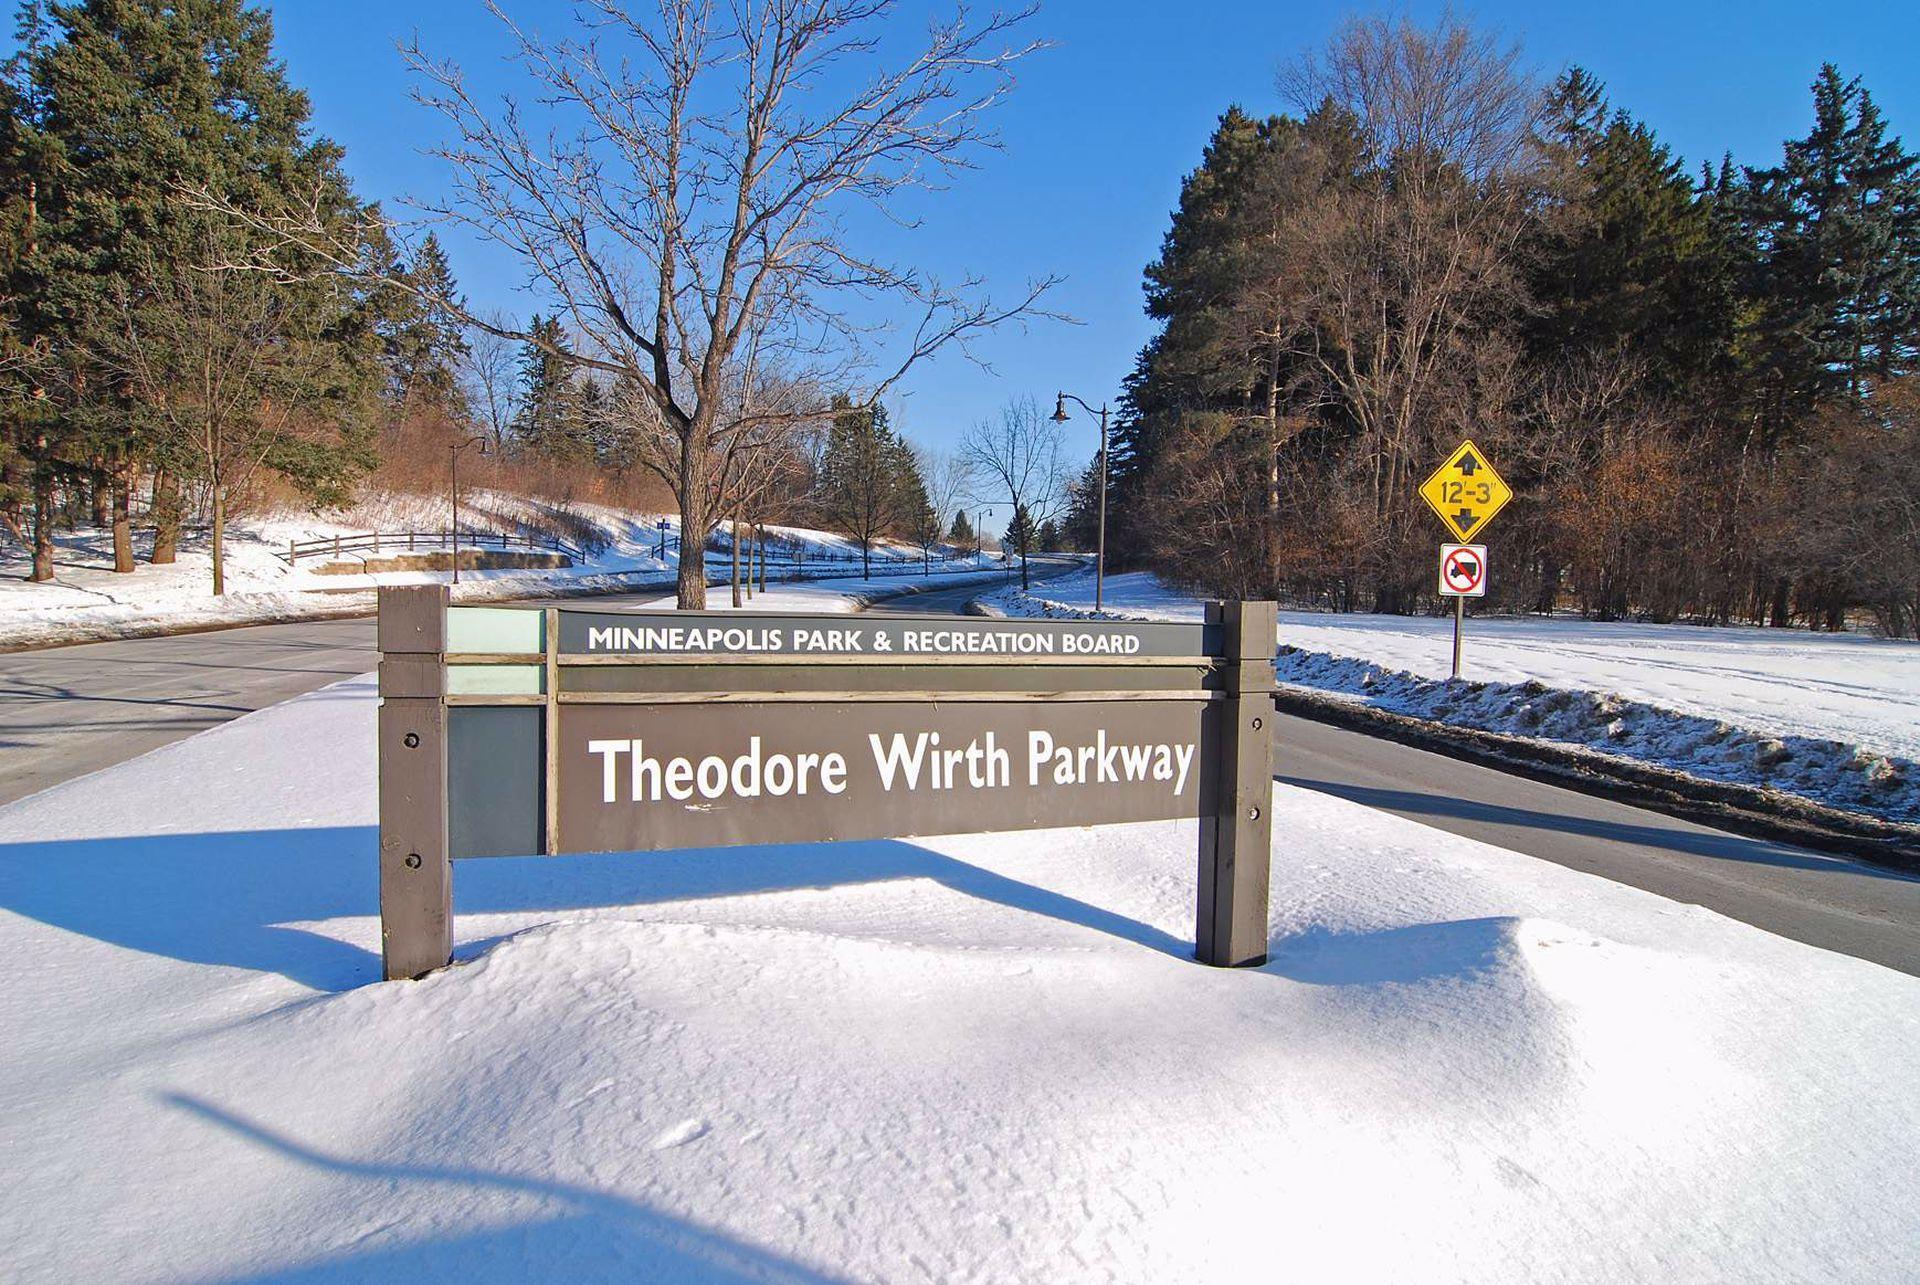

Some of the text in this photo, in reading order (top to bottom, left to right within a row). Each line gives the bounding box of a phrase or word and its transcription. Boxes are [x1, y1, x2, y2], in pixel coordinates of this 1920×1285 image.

[588, 627, 1140, 656] MINNEAPOLIS PARK & RECREATION BOARD
[588, 729, 1196, 804] Theodore Wirth Parkway
